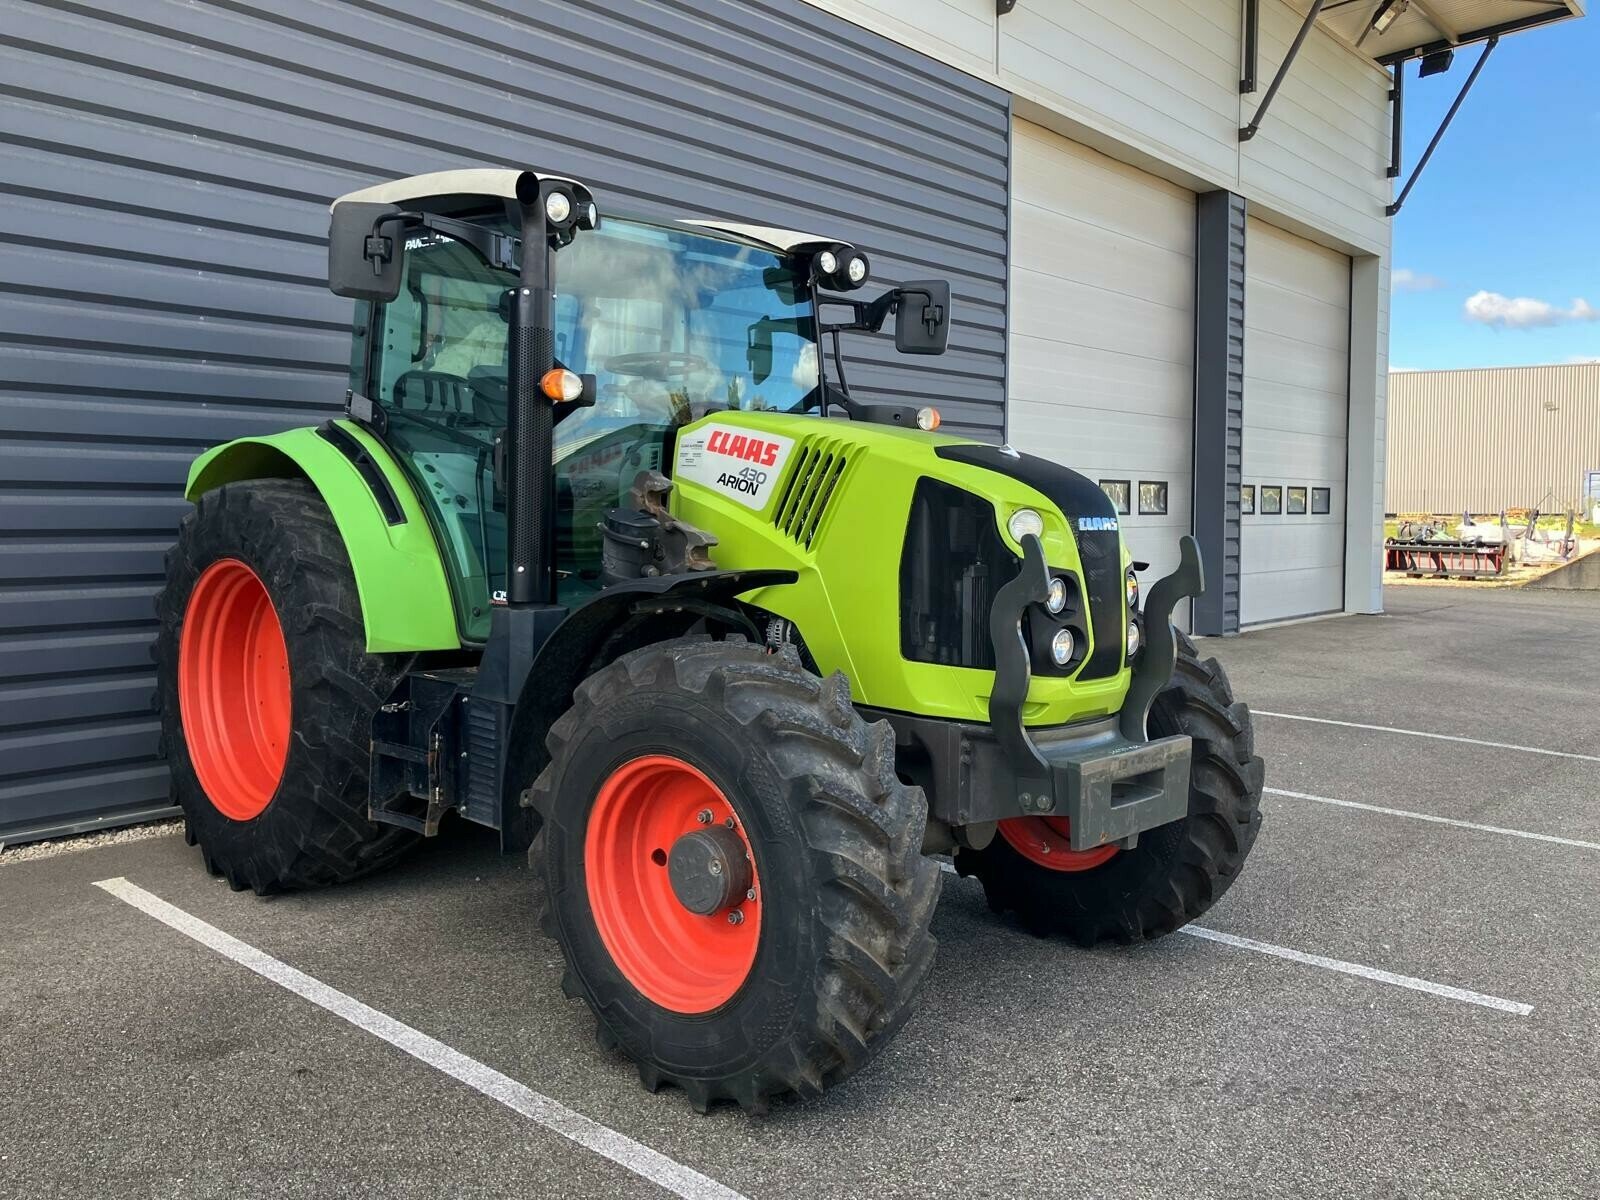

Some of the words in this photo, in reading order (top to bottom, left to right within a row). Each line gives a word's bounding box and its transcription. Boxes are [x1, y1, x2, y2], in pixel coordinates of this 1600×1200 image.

[707, 431, 779, 467] CLAAS
[717, 473, 759, 496] ARION
[739, 467, 767, 484] 430
[1078, 517, 1118, 531] CLAAS
